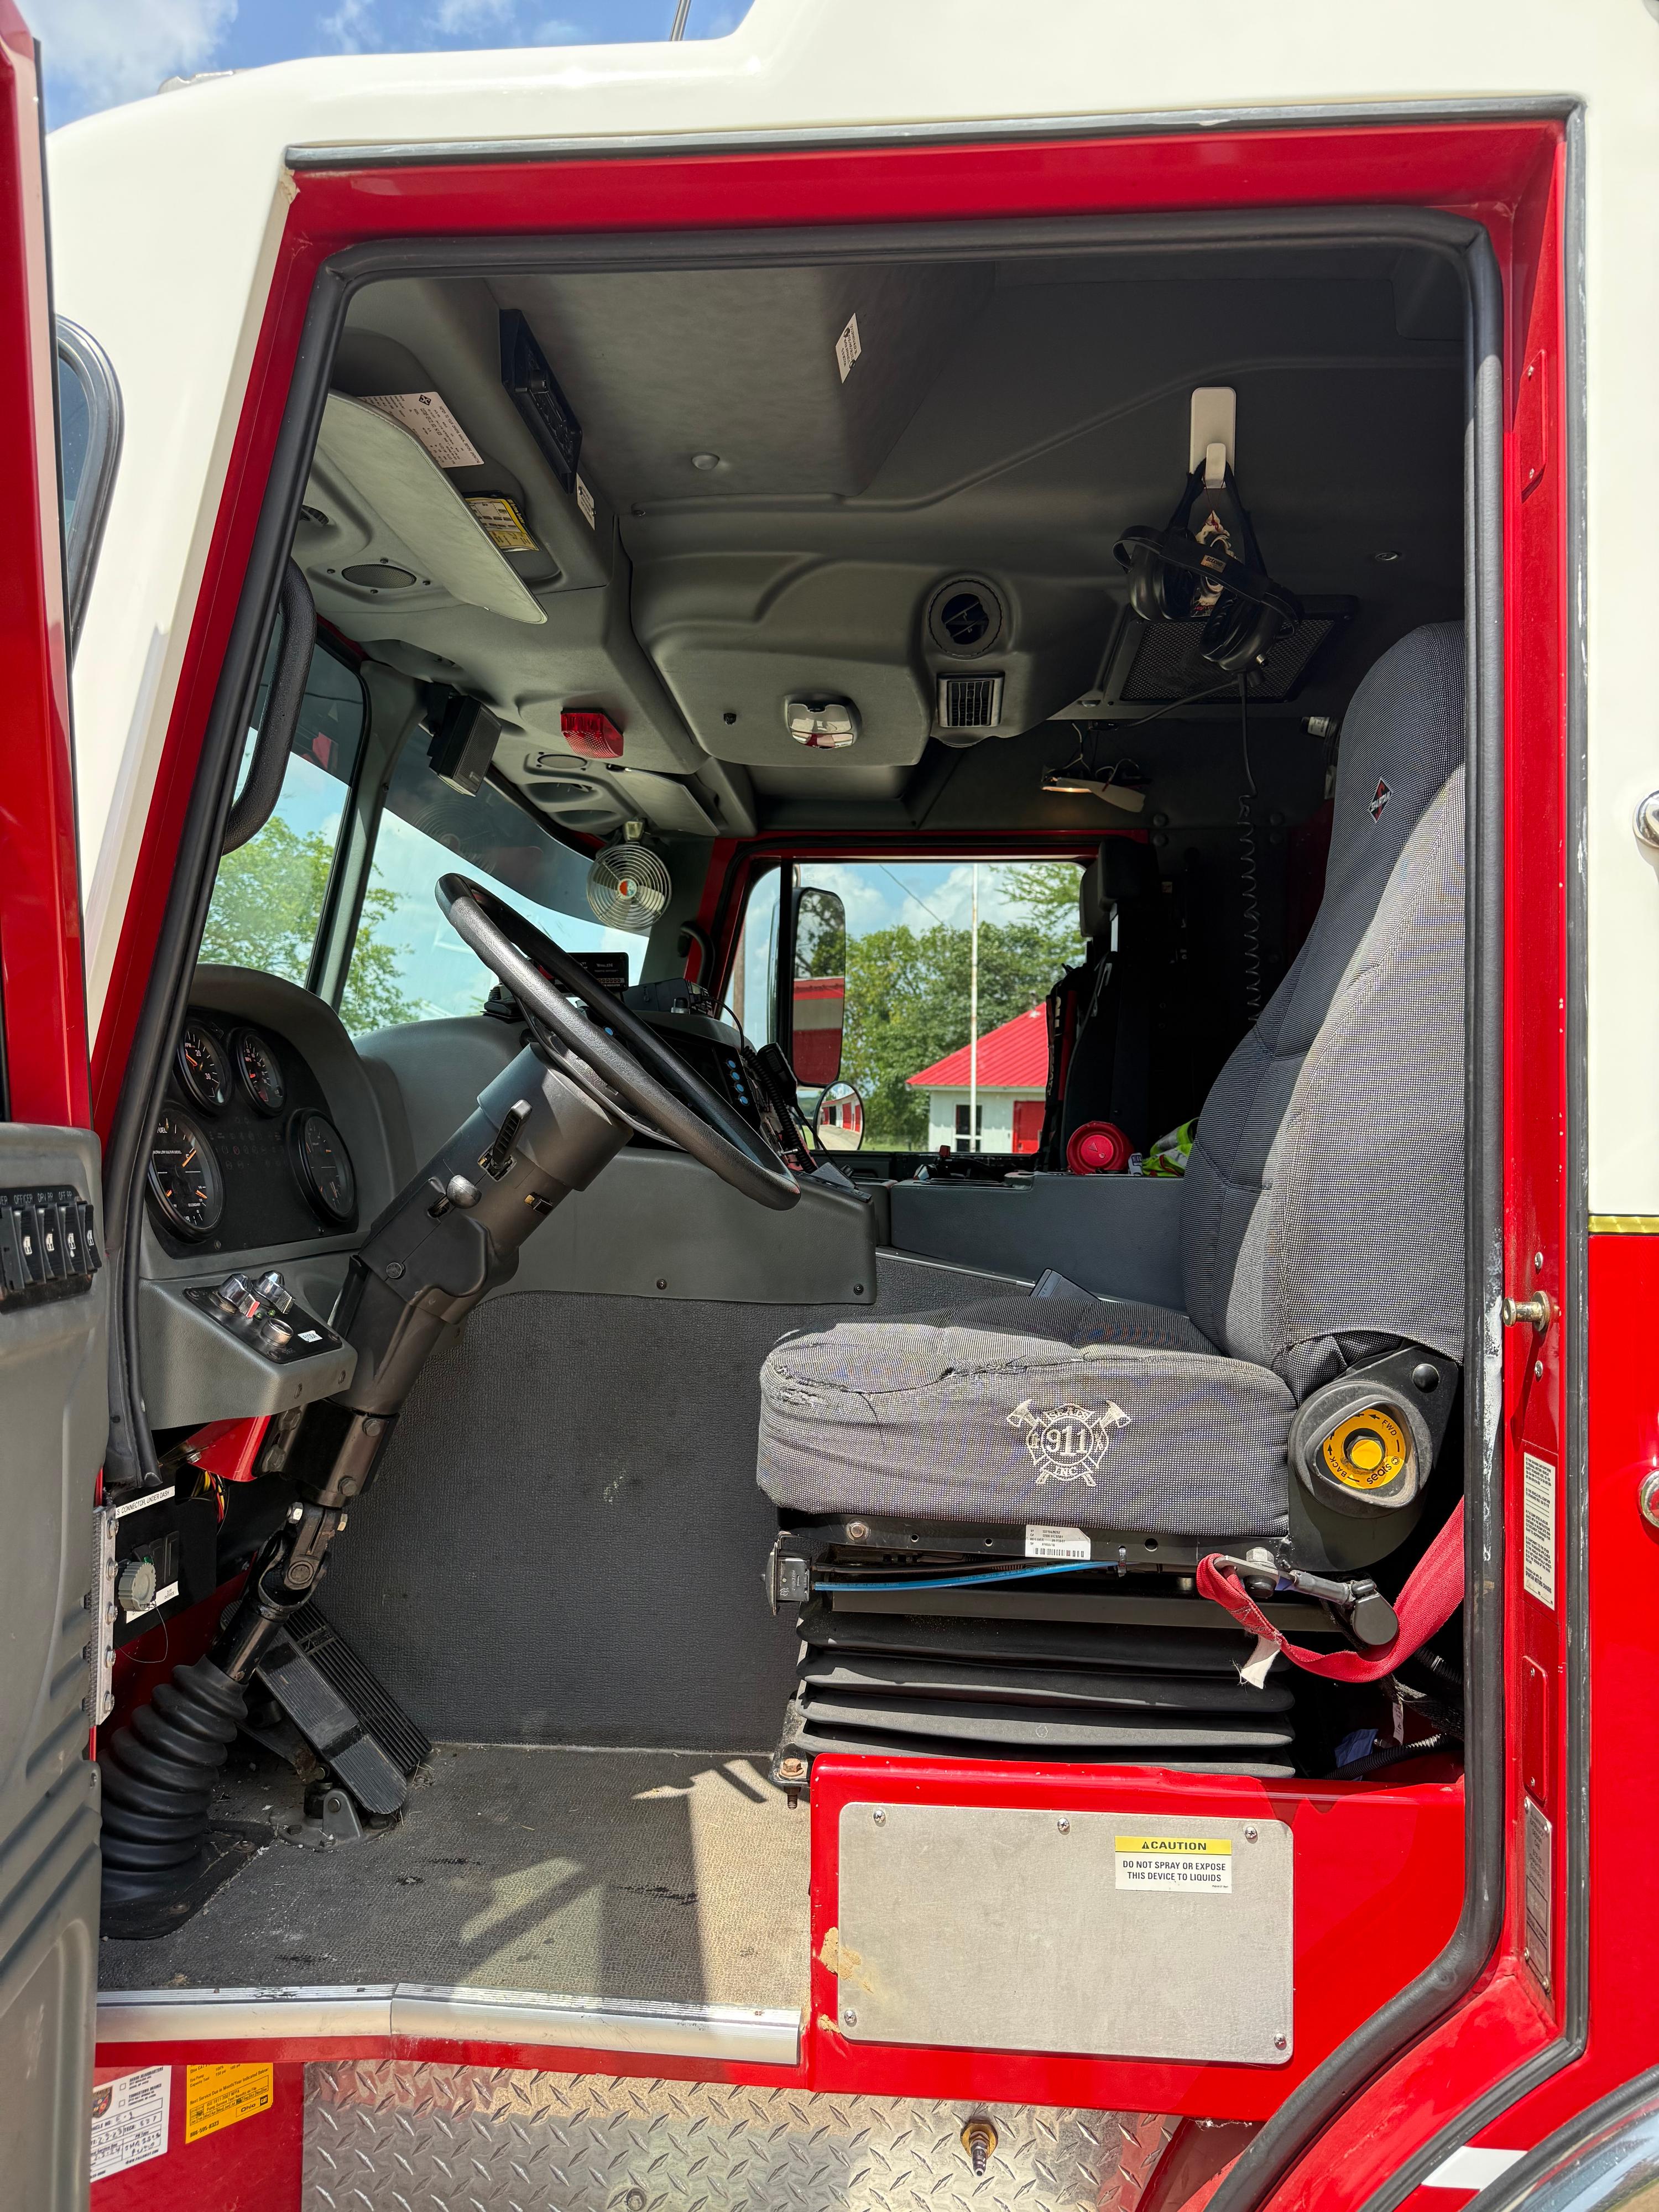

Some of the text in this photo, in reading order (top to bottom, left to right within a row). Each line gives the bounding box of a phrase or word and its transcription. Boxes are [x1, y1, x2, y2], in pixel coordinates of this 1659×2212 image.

[14, 1194, 33, 1204] OFFICER
[1382, 1420, 1397, 1436] FWD
[1046, 1425, 1088, 1457] 911
[1329, 1456, 1348, 1478] BACK
[1366, 1463, 1392, 1484] seats
[1151, 1841, 1206, 1850] CAUTION
[241, 2103, 255, 2112] Ohio
